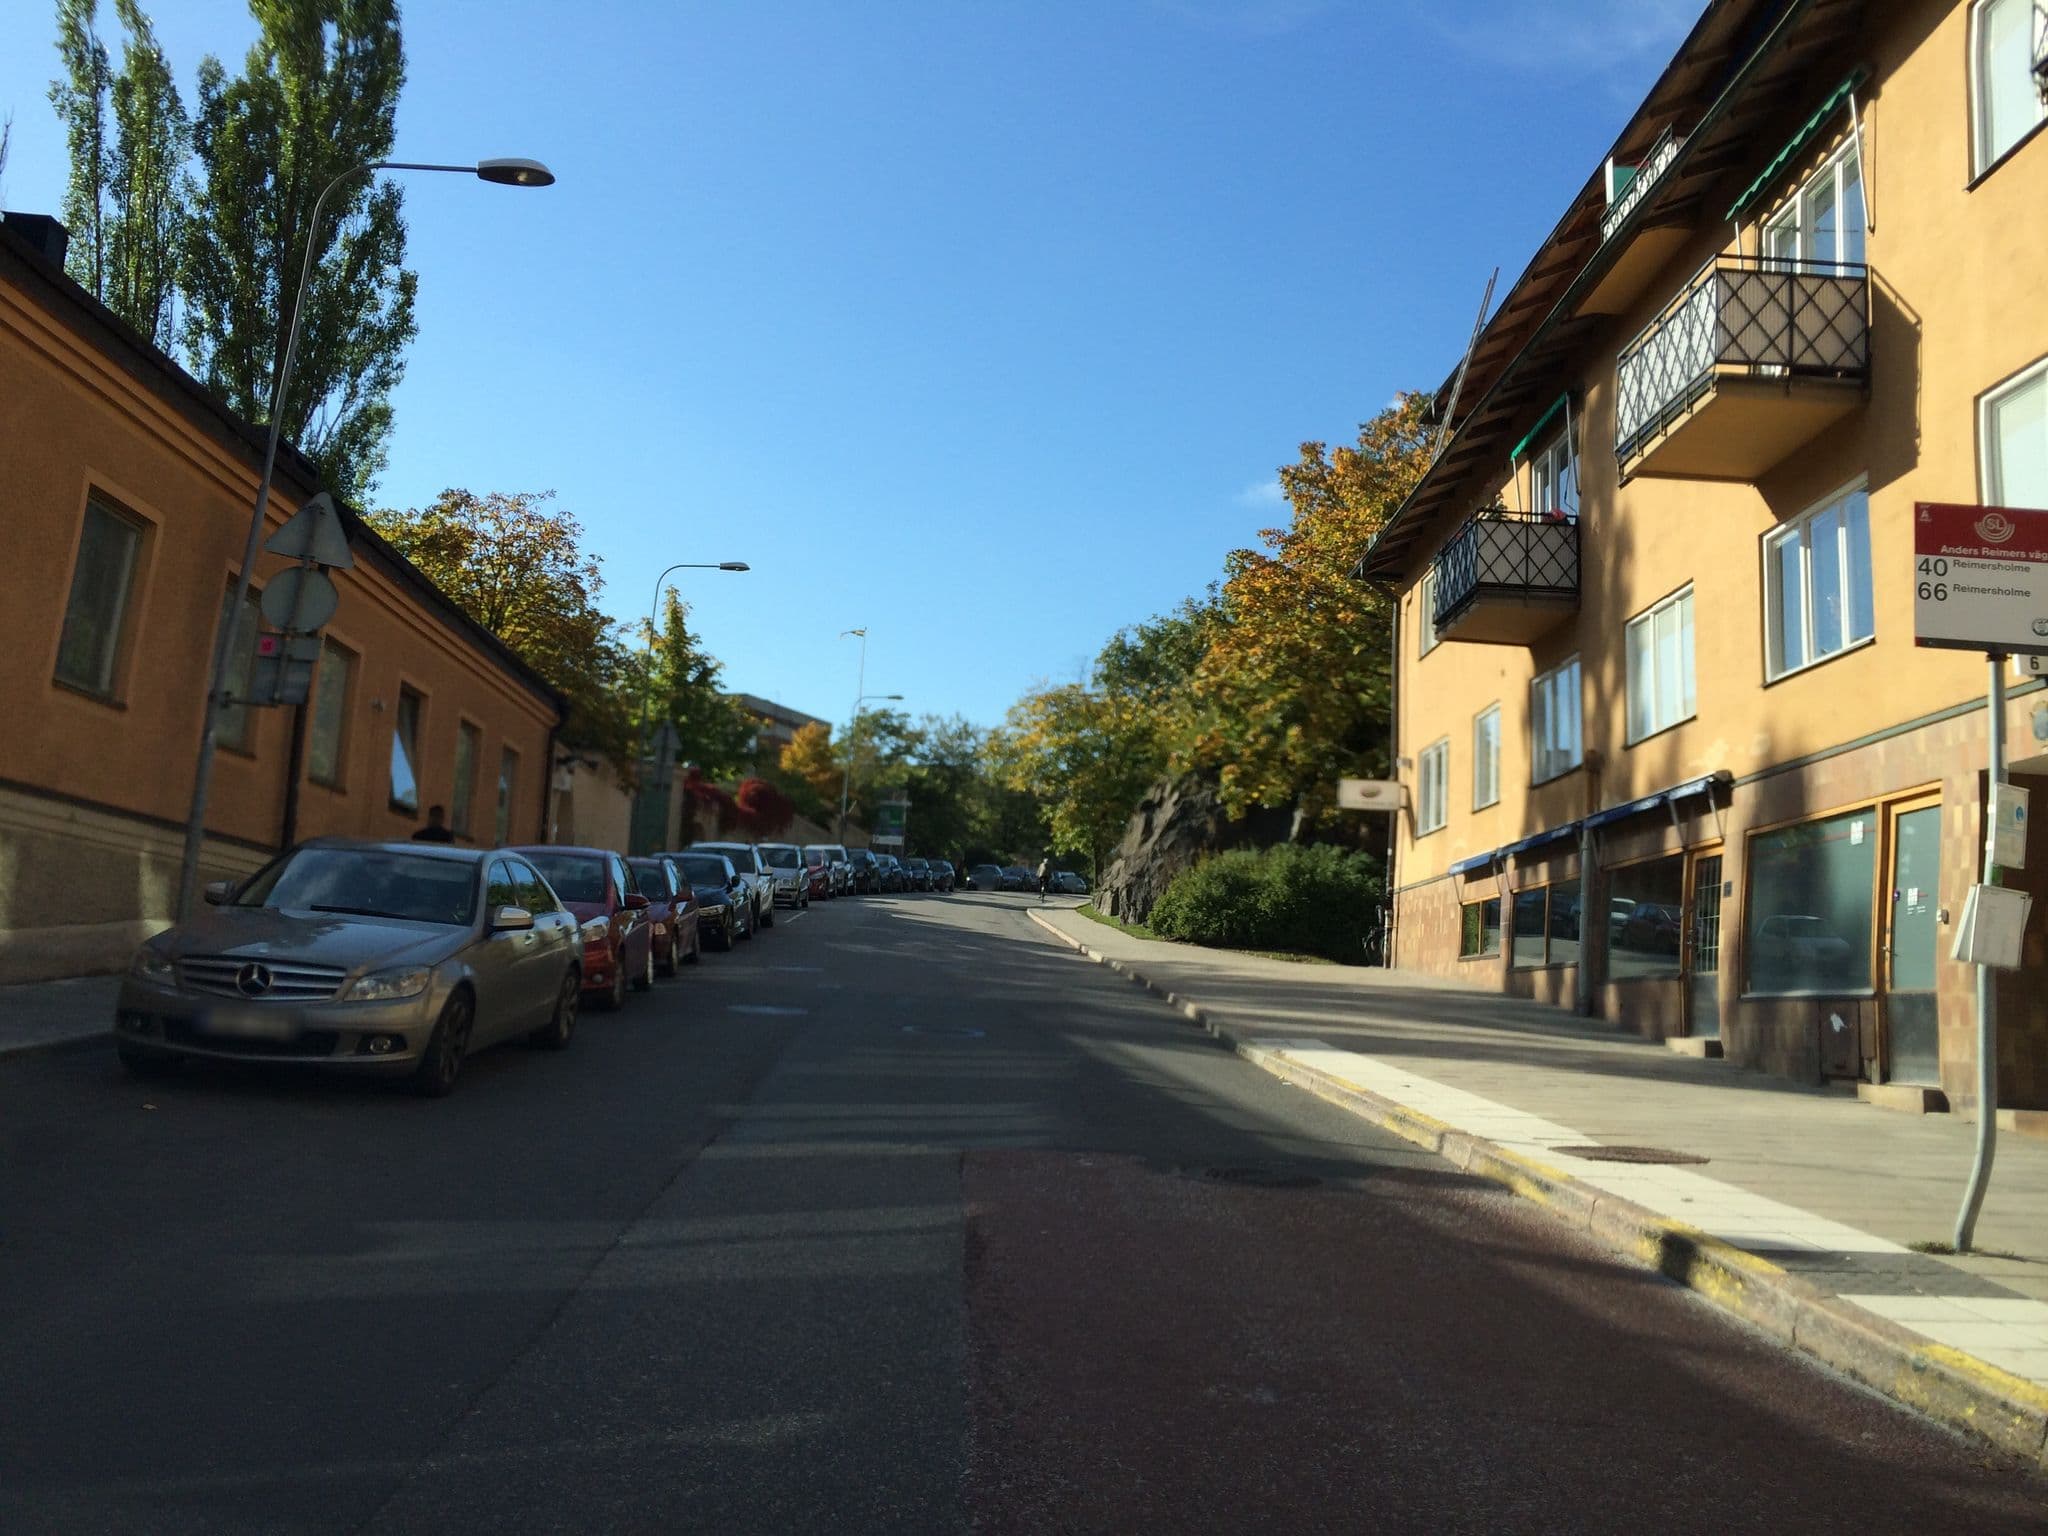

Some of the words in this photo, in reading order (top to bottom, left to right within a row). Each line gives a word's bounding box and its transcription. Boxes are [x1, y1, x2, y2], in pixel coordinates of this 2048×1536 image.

[1986, 518, 2003, 530] SL
[1940, 545, 1979, 555] Anders
[1982, 547, 2026, 559] Reimers
[1918, 557, 1948, 577] 40
[1953, 560, 2031, 573] Reimersholme
[1918, 581, 1948, 601] 66
[1953, 584, 2031, 597] Reimersholme
[2030, 656, 2039, 670] 6
